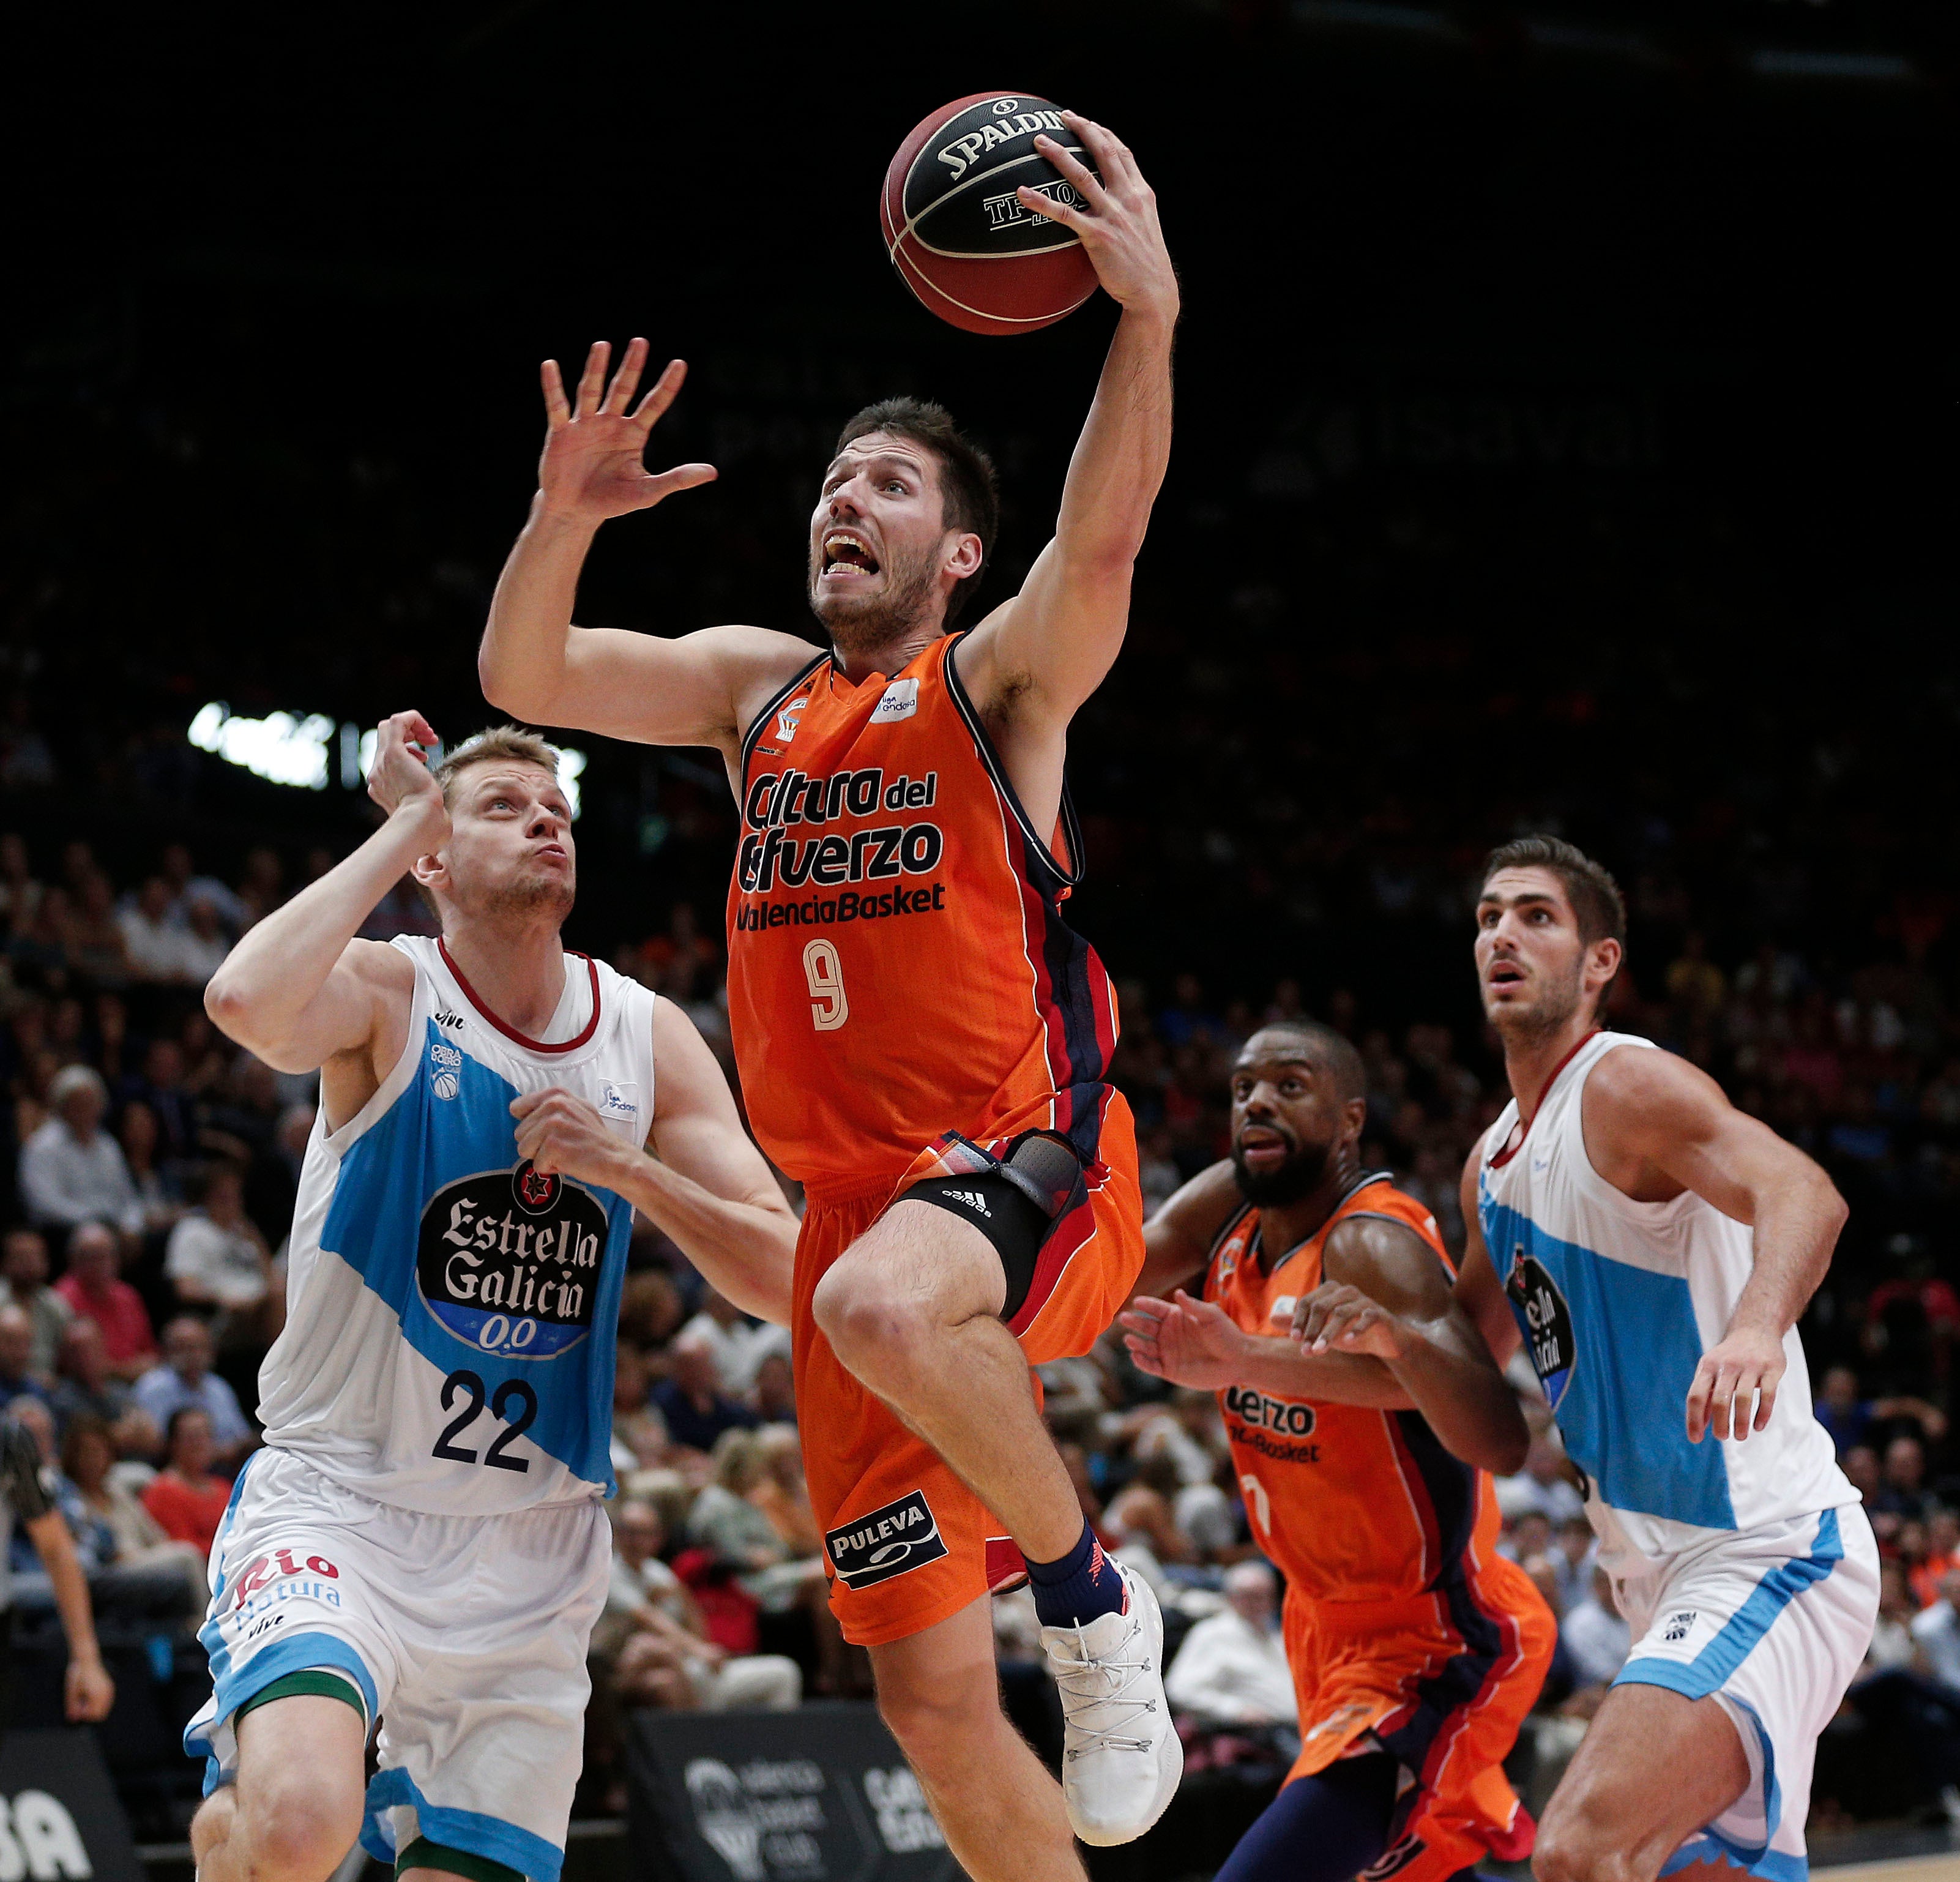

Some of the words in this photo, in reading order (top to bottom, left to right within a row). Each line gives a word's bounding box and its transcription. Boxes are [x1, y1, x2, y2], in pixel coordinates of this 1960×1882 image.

[937, 110, 1065, 181] SPALDIN
[746, 767, 882, 832] Cltura
[885, 771, 937, 810] del
[803, 939, 849, 1031] 9
[442, 1198, 598, 1270] Estrella
[444, 1251, 584, 1319] Galicia
[432, 1370, 538, 1474] 22
[832, 1506, 926, 1559] PULEVA
[236, 1548, 338, 1610] Rio
[248, 1615, 283, 1640] vive
